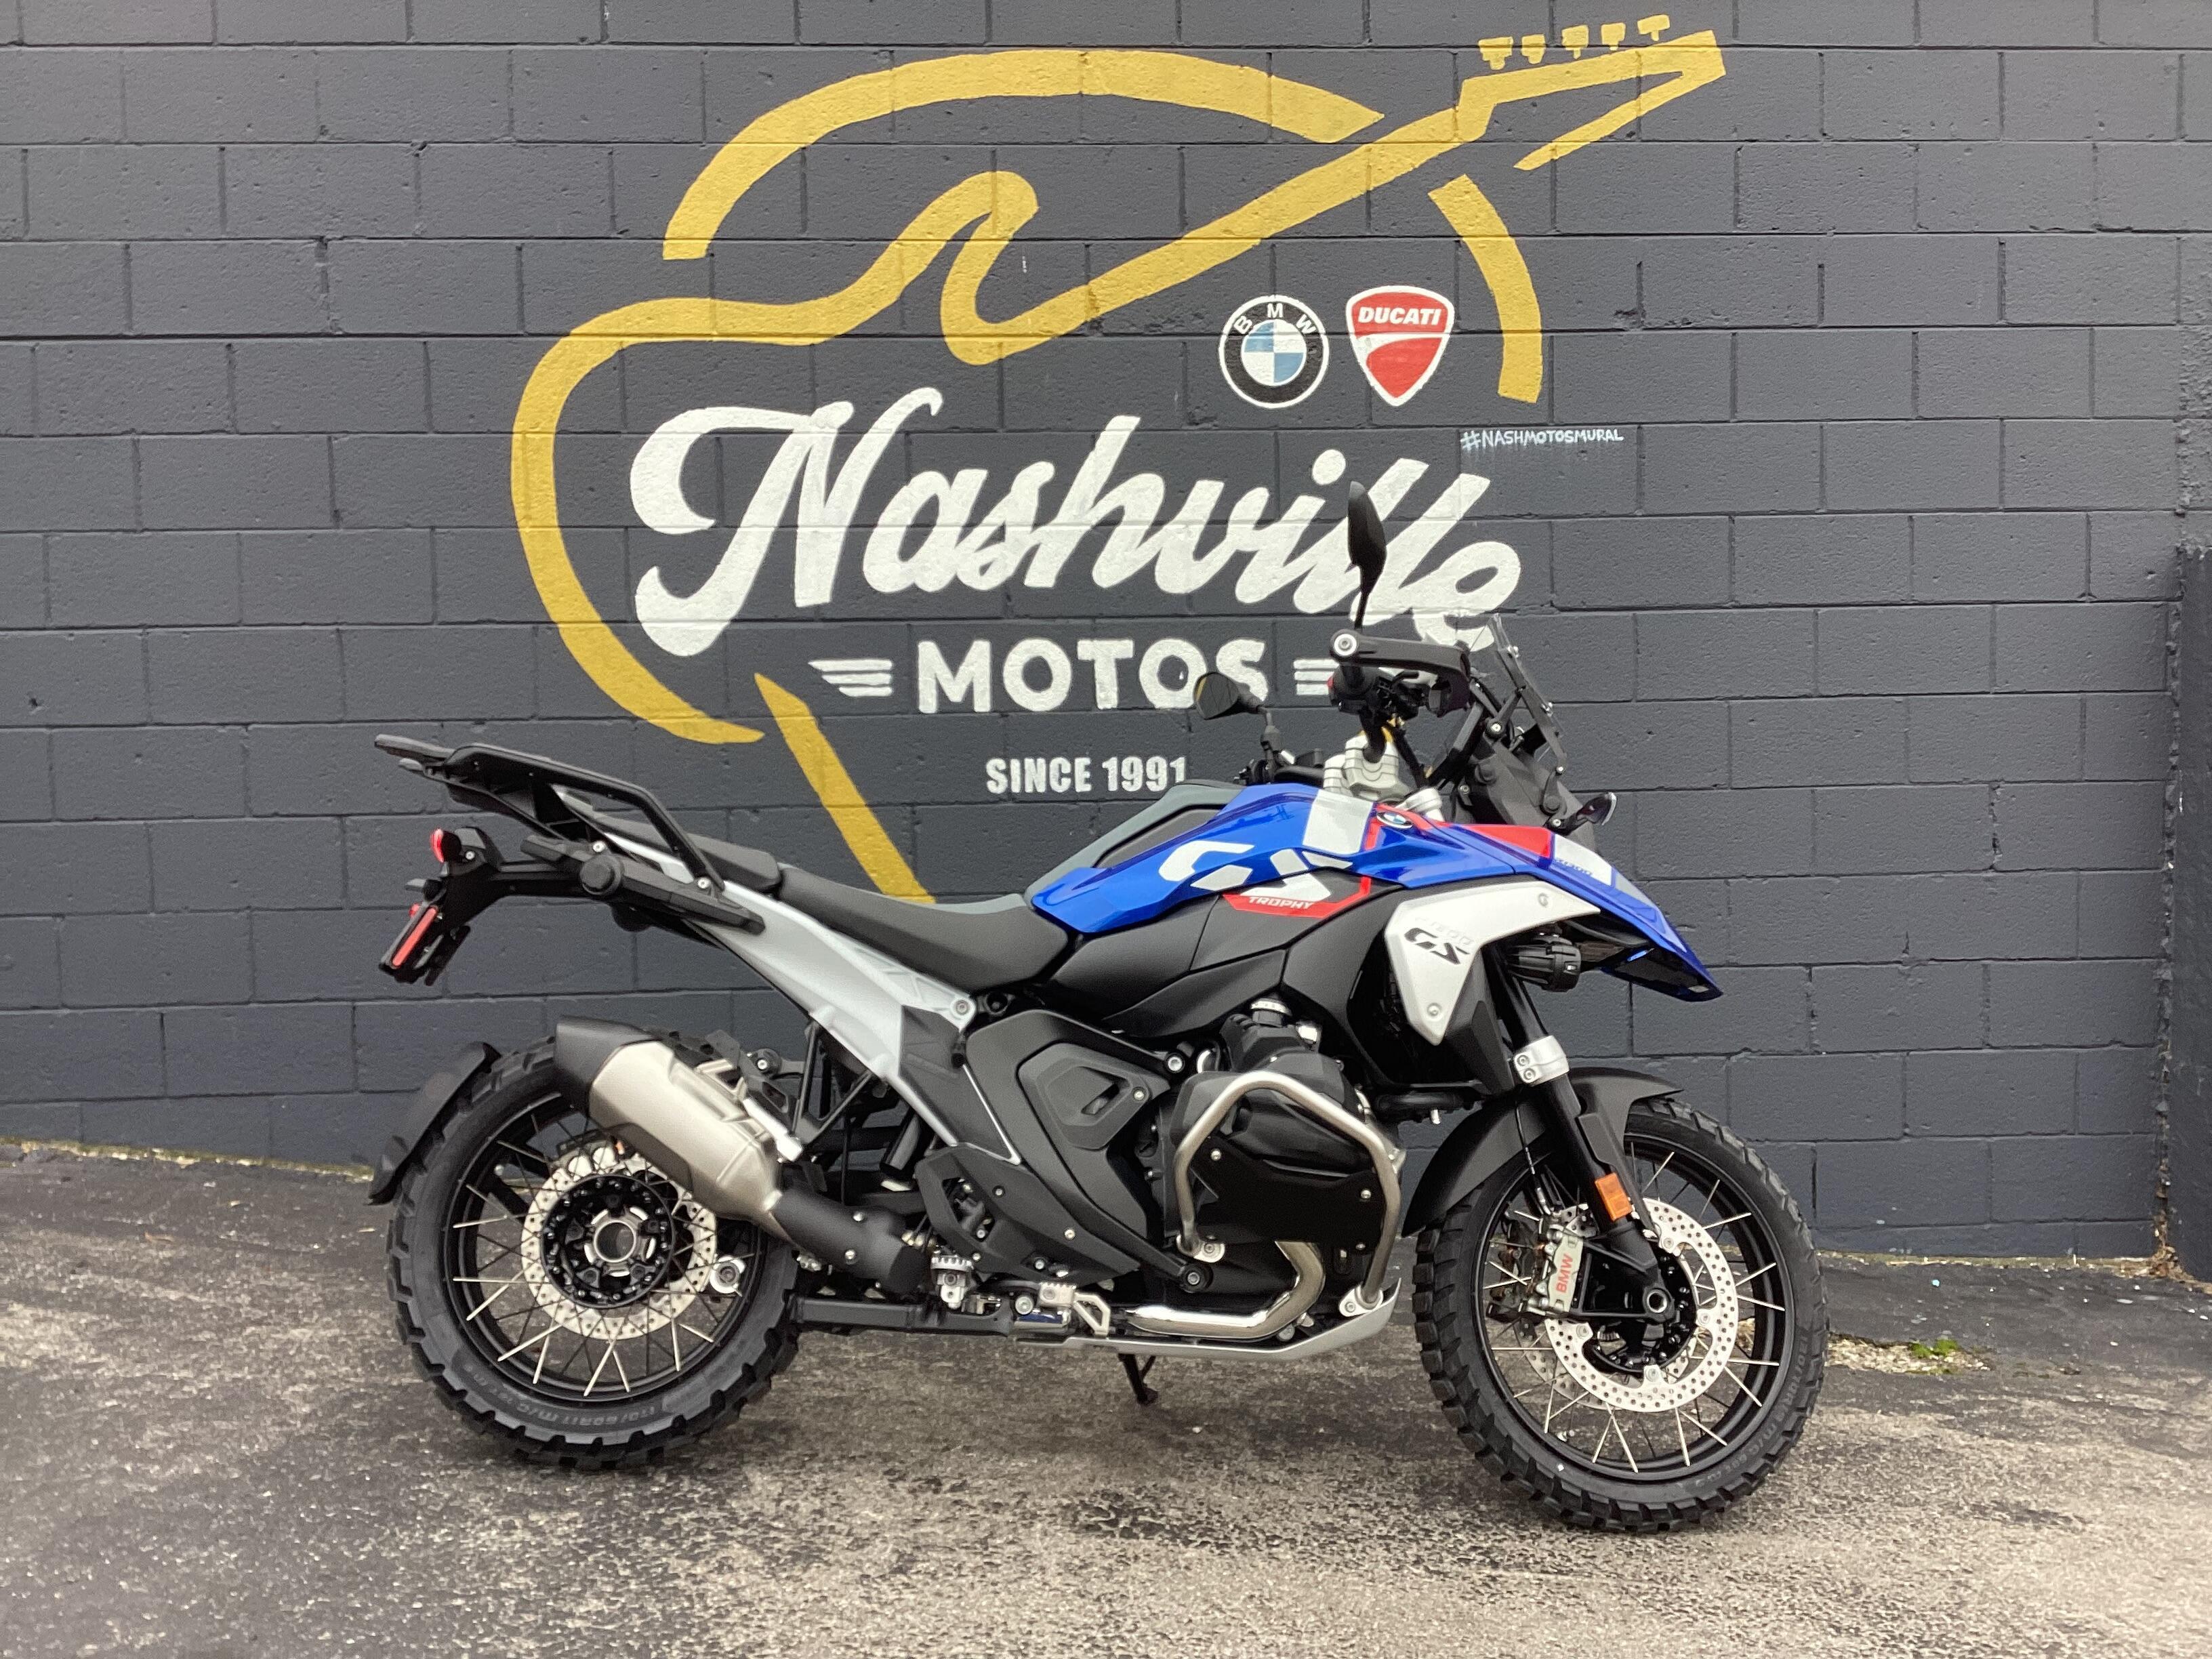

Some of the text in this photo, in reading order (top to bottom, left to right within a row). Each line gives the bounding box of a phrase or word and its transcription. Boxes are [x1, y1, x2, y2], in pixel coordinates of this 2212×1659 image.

[1233, 302, 1317, 335] BMW
[1357, 306, 1441, 326] DUCATI
[1460, 429, 1624, 451] #NASHMOTOSMURAL
[630, 388, 1521, 656] Nashville
[918, 638, 1269, 714] MOTOS
[985, 756, 1186, 794] SINCE 1991
[1248, 896, 1315, 909] TROPHY
[1555, 1253, 1573, 1293] BMW
